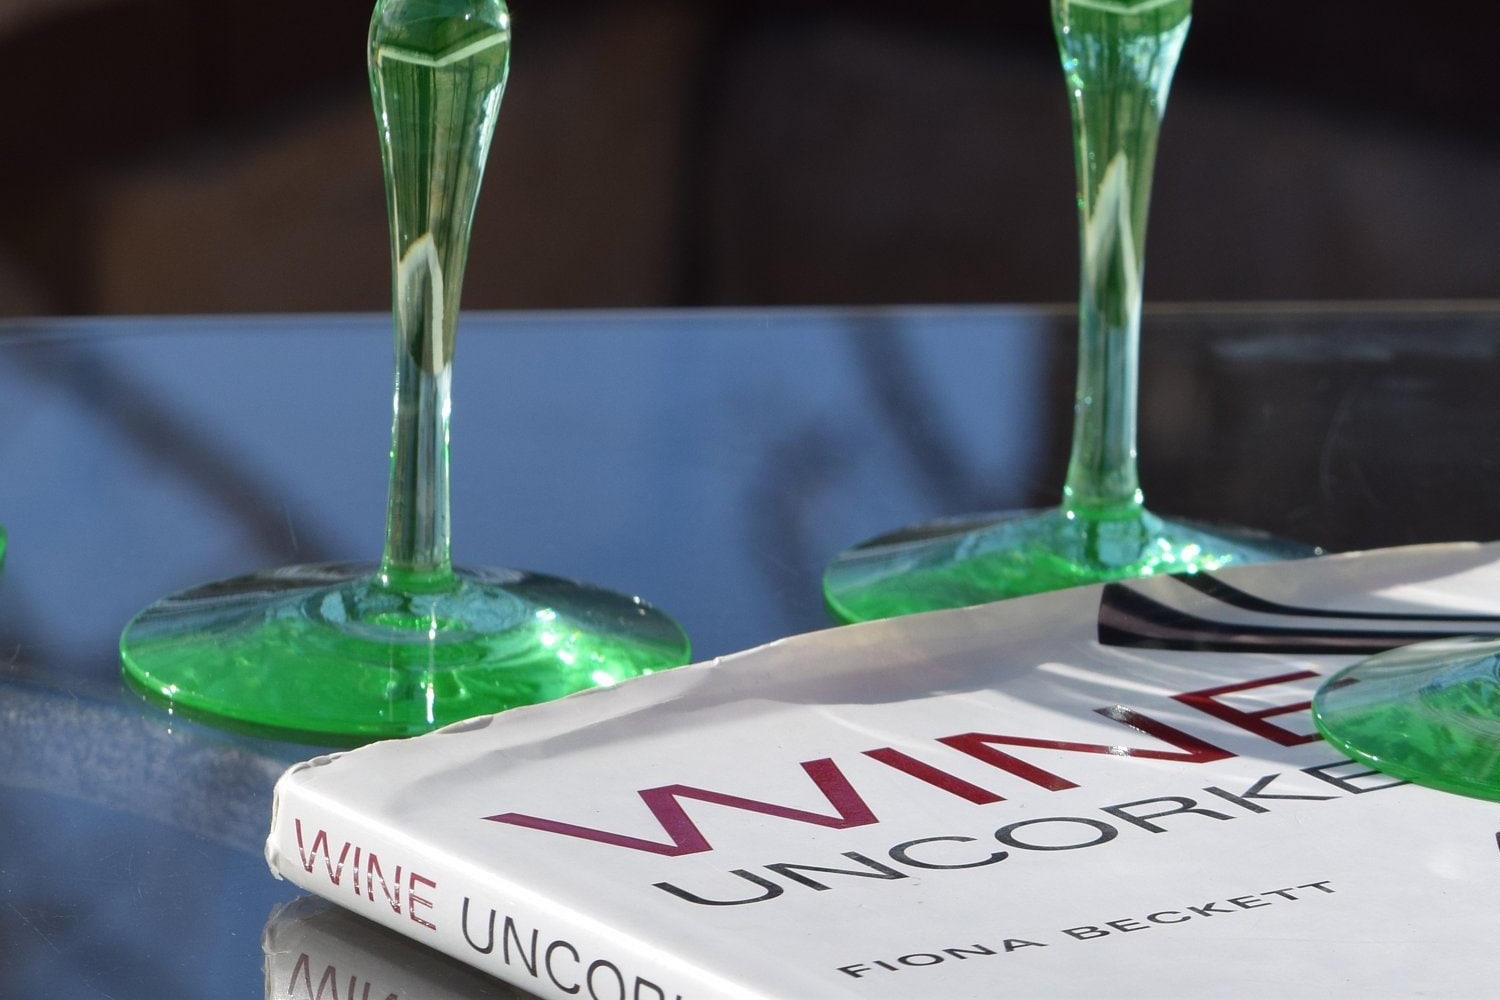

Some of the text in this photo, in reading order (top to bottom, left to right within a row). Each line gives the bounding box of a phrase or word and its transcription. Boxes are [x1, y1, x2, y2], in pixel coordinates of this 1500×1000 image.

[481, 670, 1361, 858] WINE
[295, 818, 437, 931] WINE
[653, 758, 1415, 906] UNCORKE
[837, 880, 1336, 979] FIONA BECKETT
